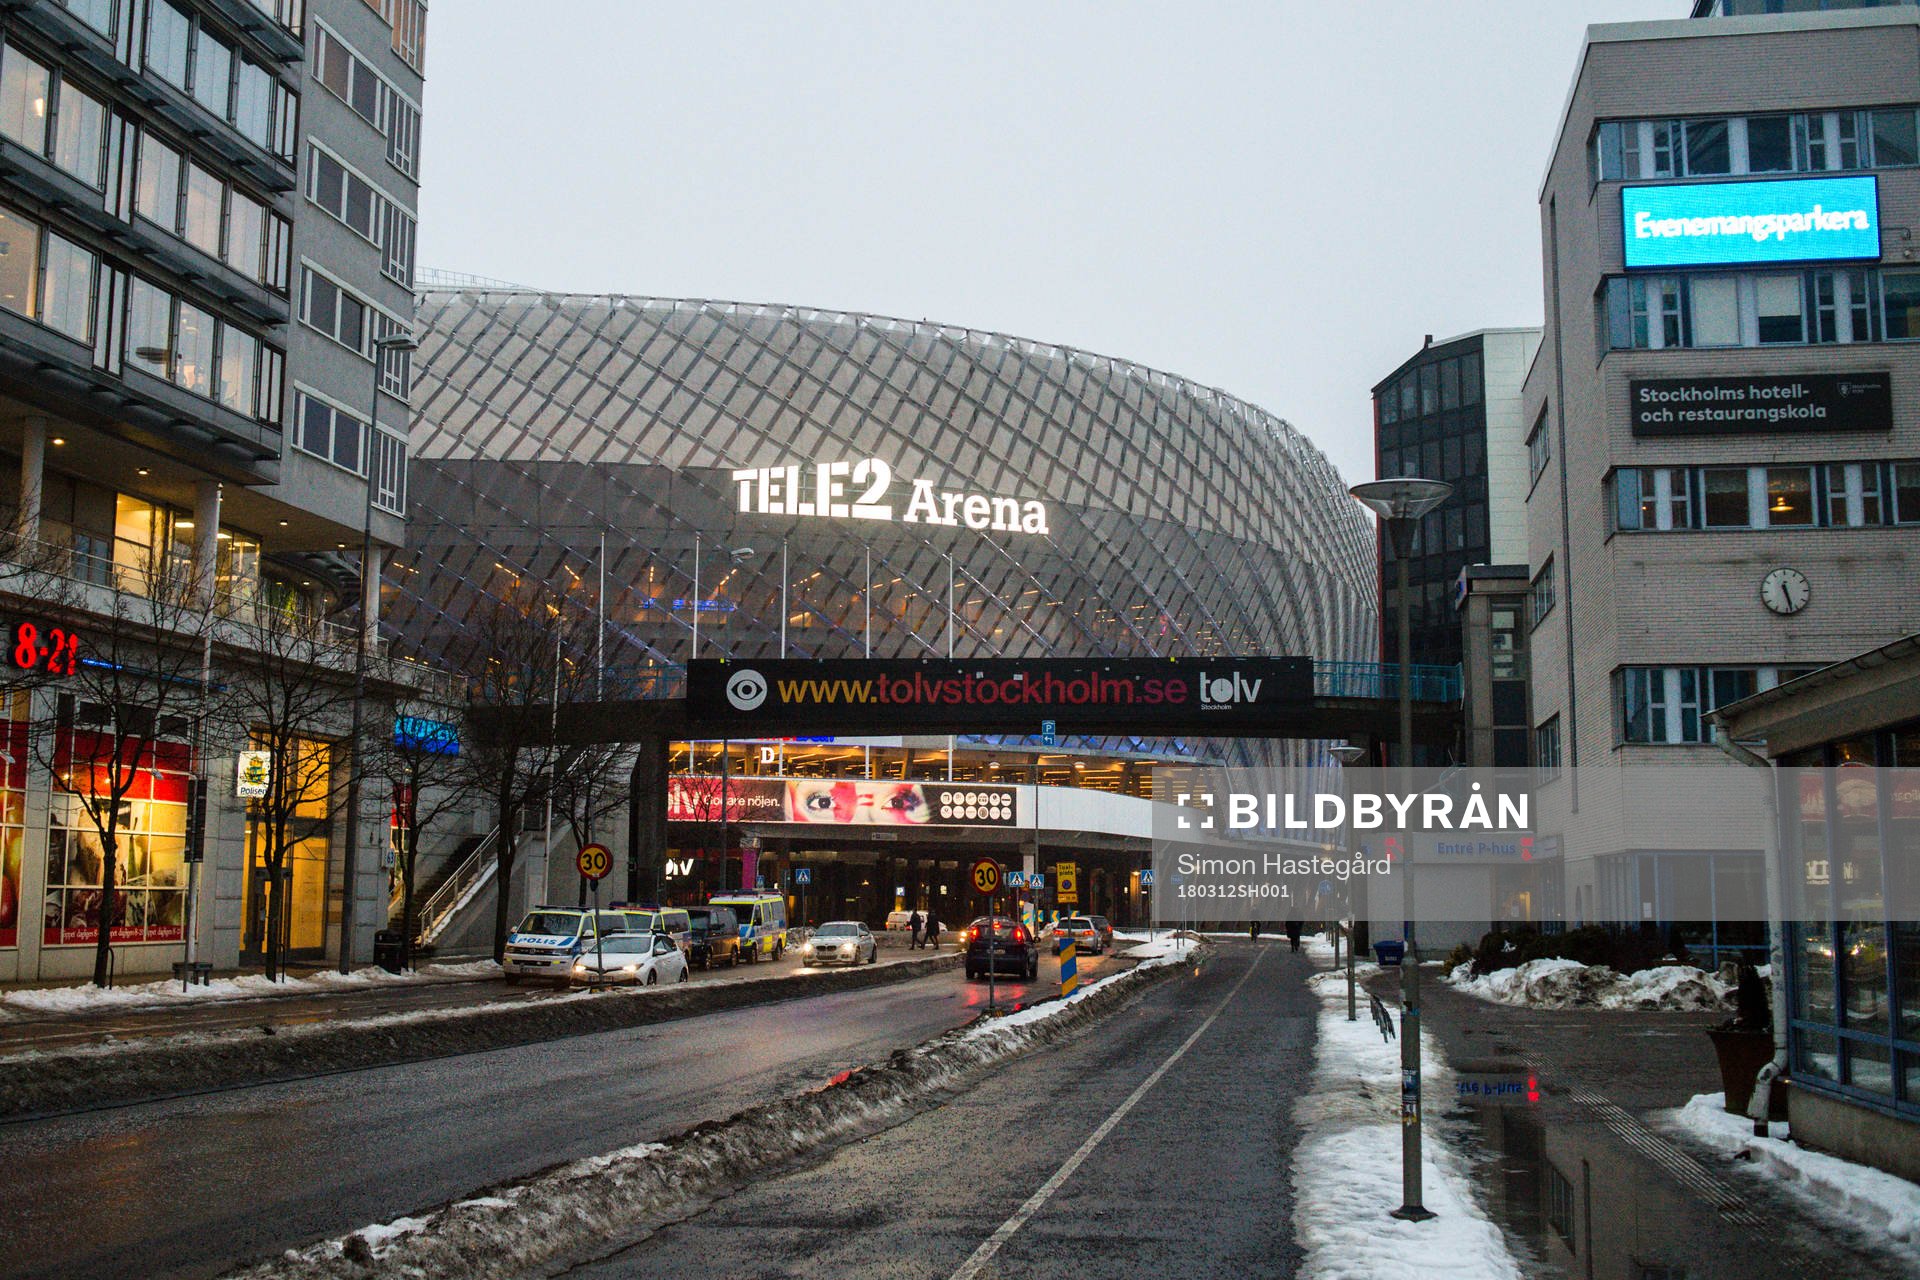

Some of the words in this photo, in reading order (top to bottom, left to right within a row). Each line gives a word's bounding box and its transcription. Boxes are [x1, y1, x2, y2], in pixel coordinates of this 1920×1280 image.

[1634, 204, 1870, 242] Evenemangsparkera
[1640, 386, 1745, 403] Stockholms
[1748, 383, 1810, 399] hotell-
[1640, 407, 1674, 423] och
[1678, 403, 1827, 423] restaurangskola
[733, 457, 893, 521] TELE2
[903, 478, 1049, 535] Arena
[777, 672, 1188, 705] www.tolvstockholm.se
[1199, 671, 1262, 704] tolv
[1200, 703, 1233, 711] Stockholm
[760, 746, 775, 764] D
[703, 794, 746, 806] Goare
[747, 795, 781, 808] nöjen.
[1437, 841, 1474, 854] Entré
[1479, 842, 1516, 854] P-hus
[582, 852, 606, 871] 30
[976, 867, 997, 887] 30
[517, 937, 557, 945] POLIS
